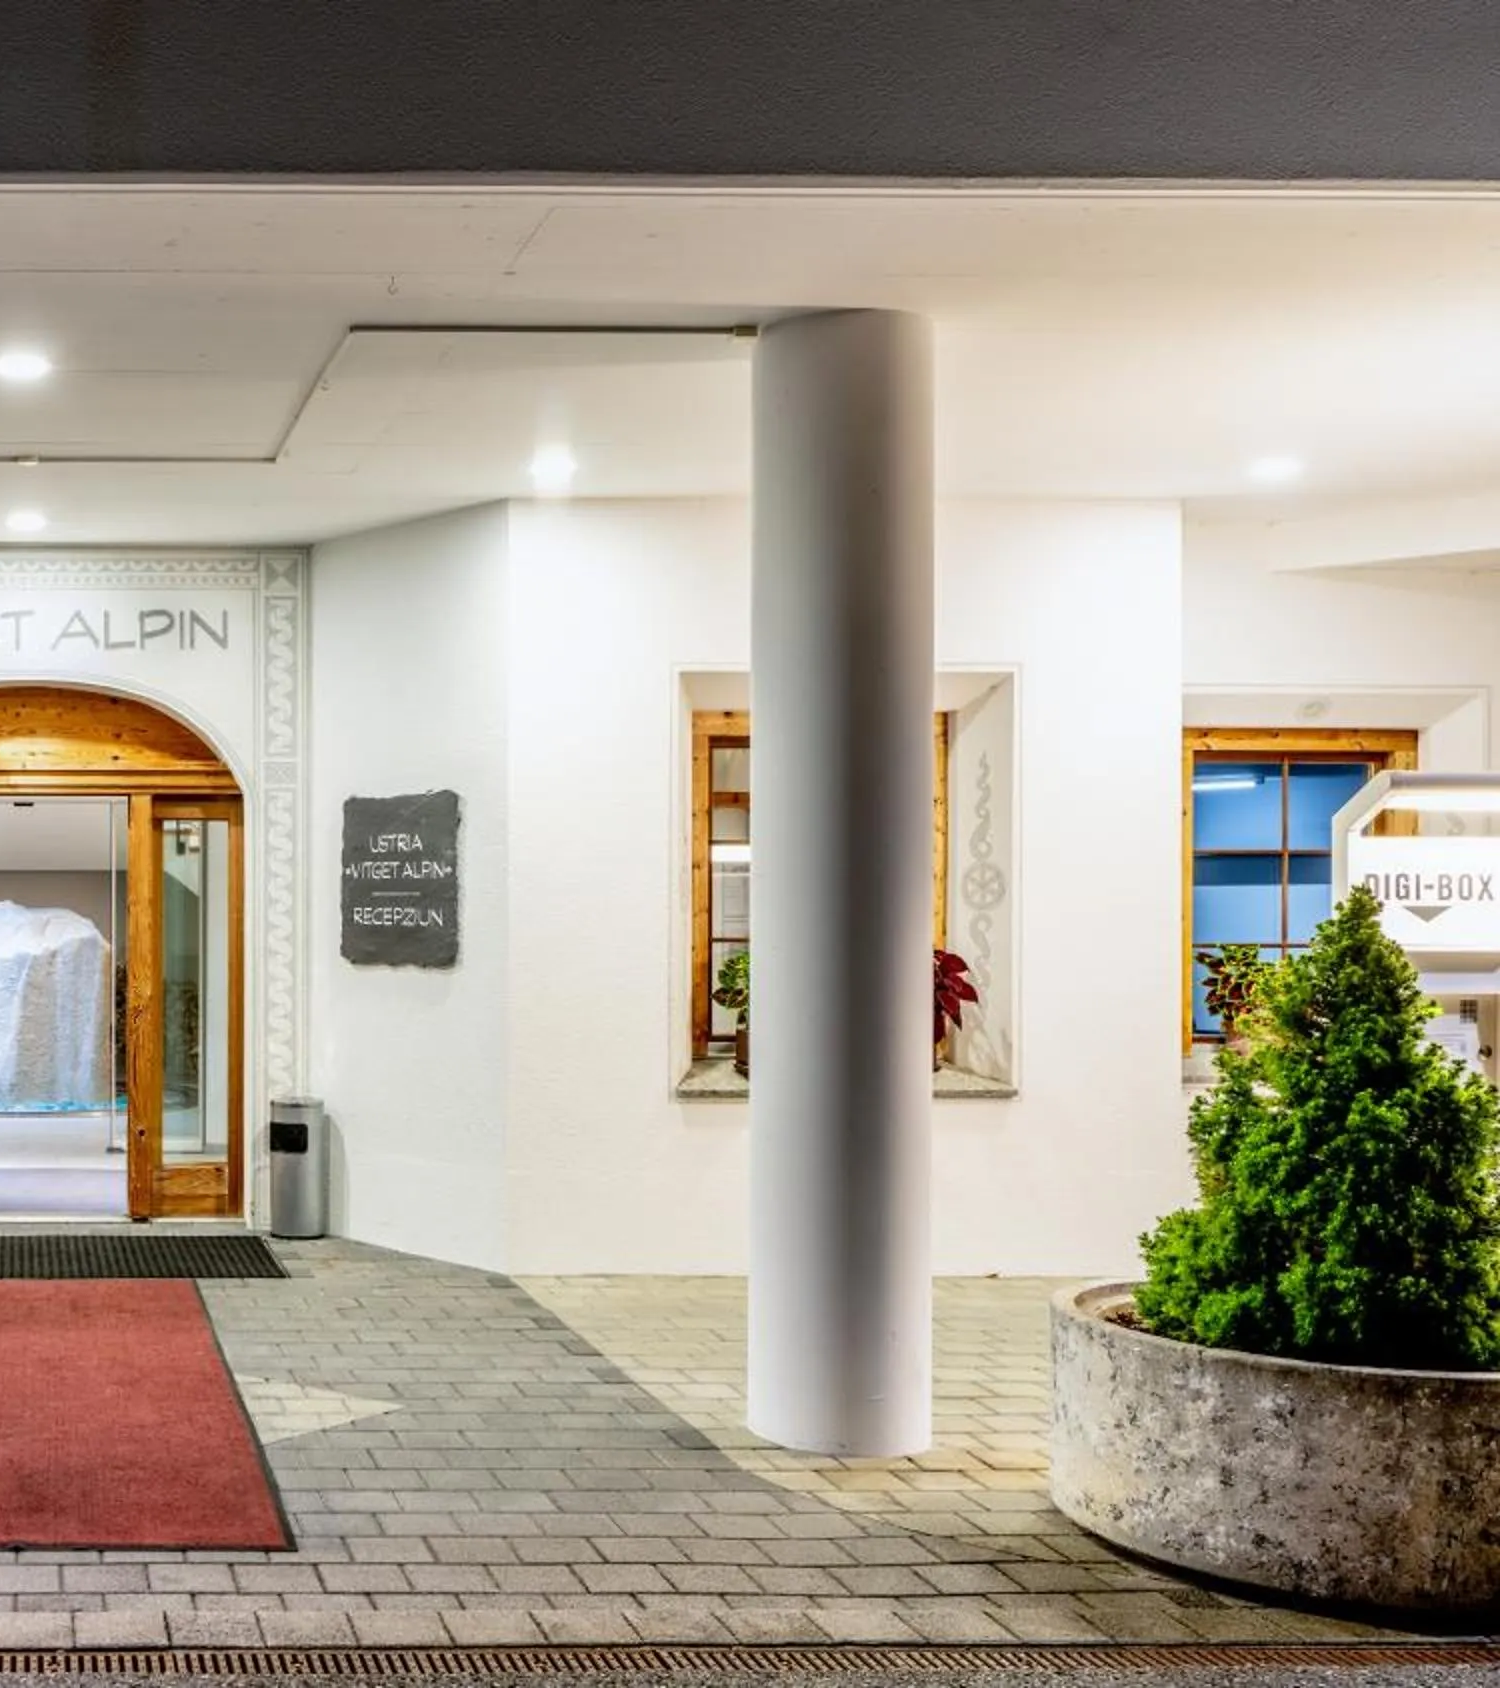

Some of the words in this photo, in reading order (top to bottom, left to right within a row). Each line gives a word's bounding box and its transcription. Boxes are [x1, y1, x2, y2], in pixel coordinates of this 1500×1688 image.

[50, 609, 229, 652] ALPIN
[369, 833, 423, 853] USTRIA
[1364, 873, 1494, 901] DIGI-BOX
[353, 907, 444, 927] RECEPZIUN
